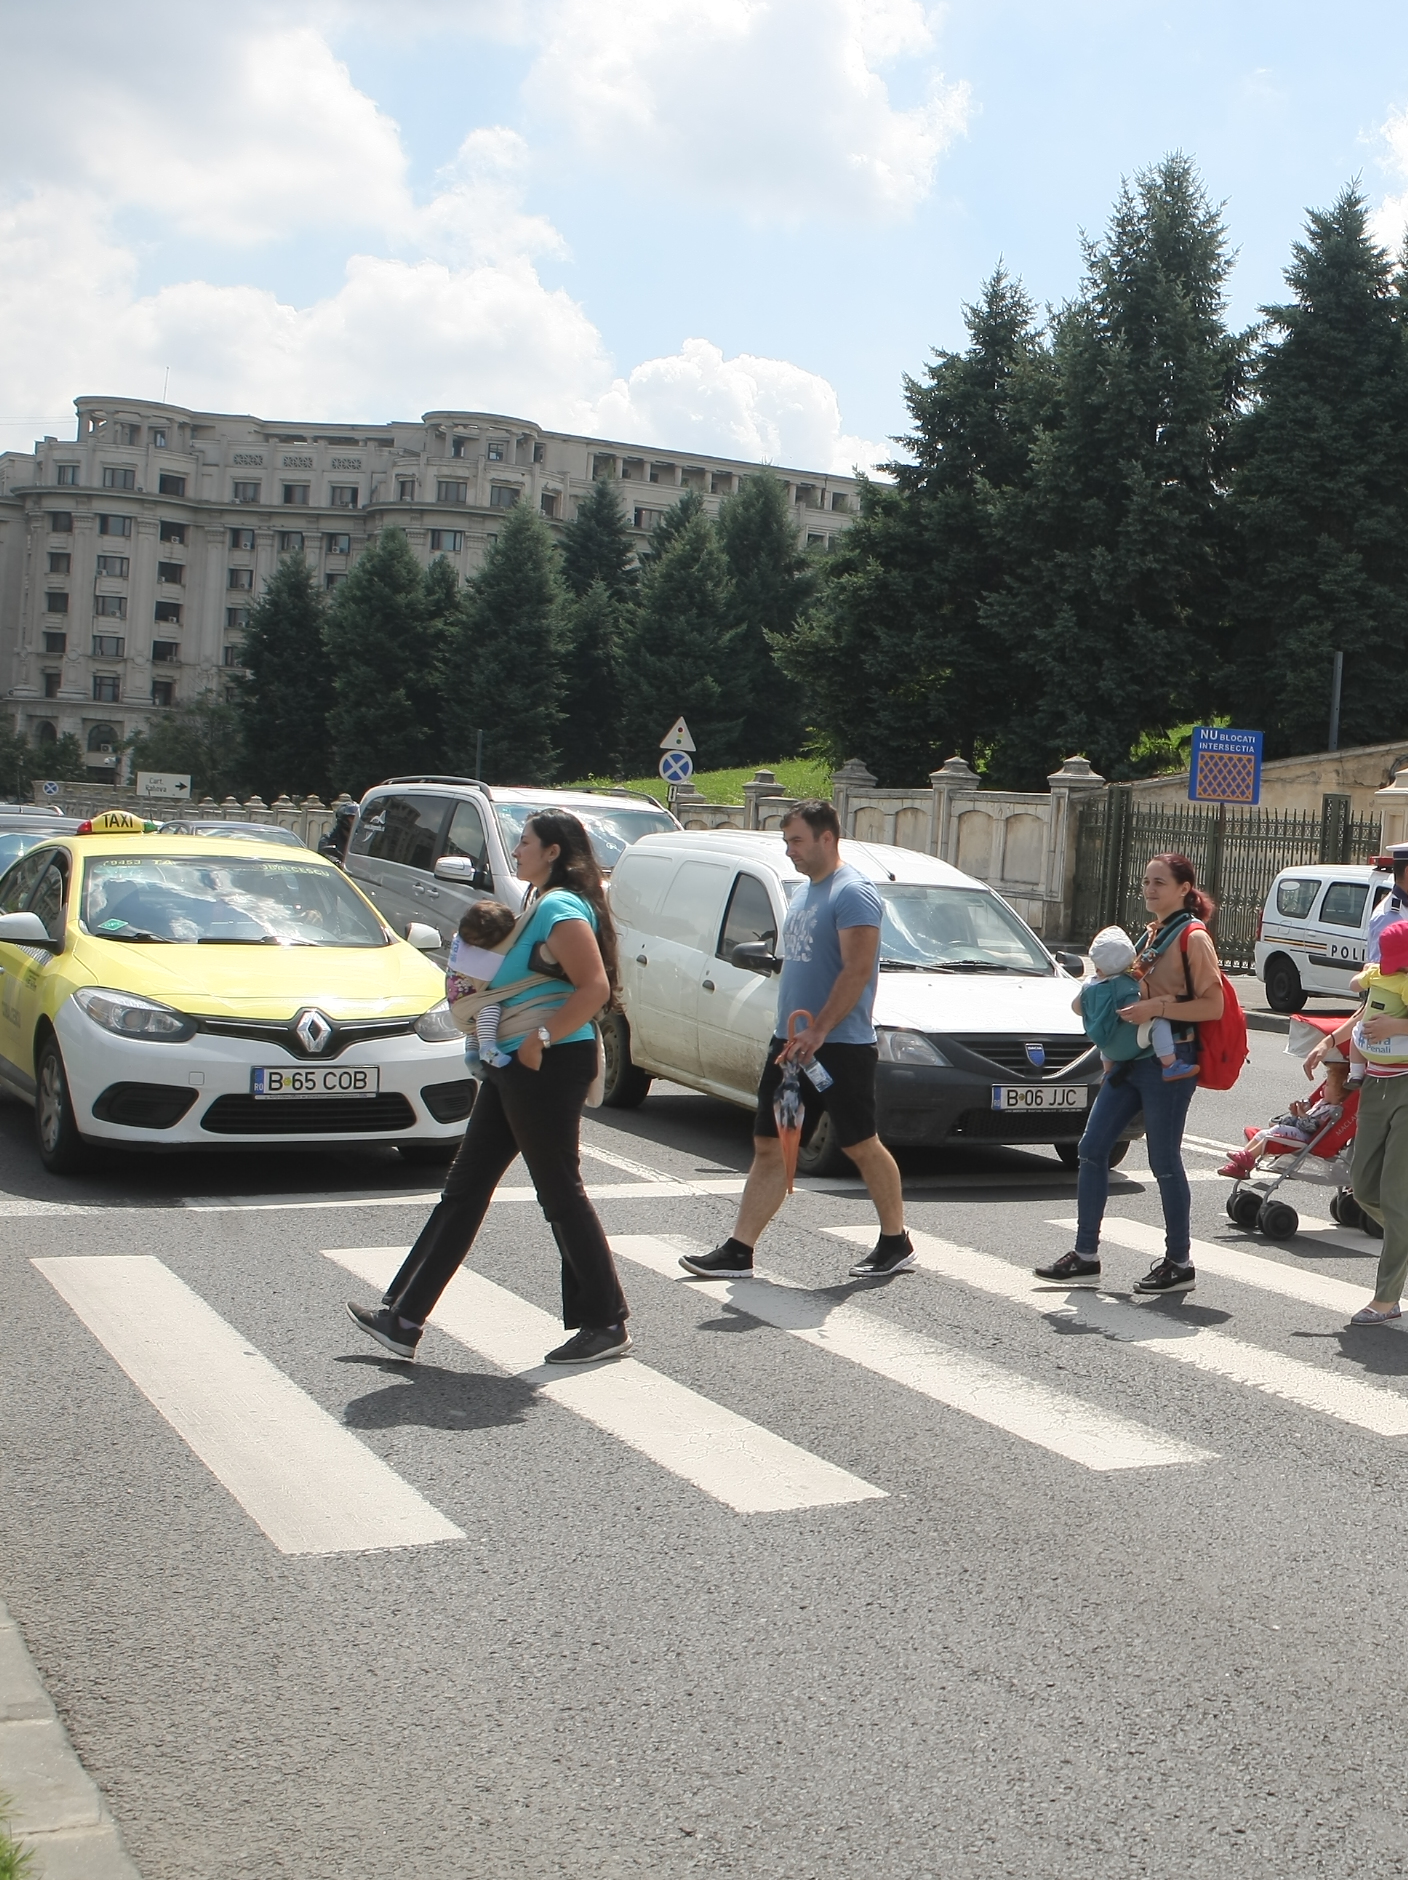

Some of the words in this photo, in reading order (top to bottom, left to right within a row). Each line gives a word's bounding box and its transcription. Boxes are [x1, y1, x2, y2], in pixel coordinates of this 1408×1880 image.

[1200, 729, 1218, 740] NU
[1219, 733, 1256, 743] BLOCATI
[1199, 742, 1255, 753] INTERSECTIA
[102, 813, 133, 828] TAXI
[1331, 944, 1365, 961] POLI
[1366, 1044, 1391, 1054] Penali
[253, 1083, 264, 1091] RO
[268, 1071, 284, 1091] B
[291, 1071, 316, 1091] 65
[323, 1071, 368, 1090] COB
[1007, 1089, 1018, 1107] B
[1025, 1089, 1043, 1106] 06
[1048, 1089, 1077, 1106] JJC
